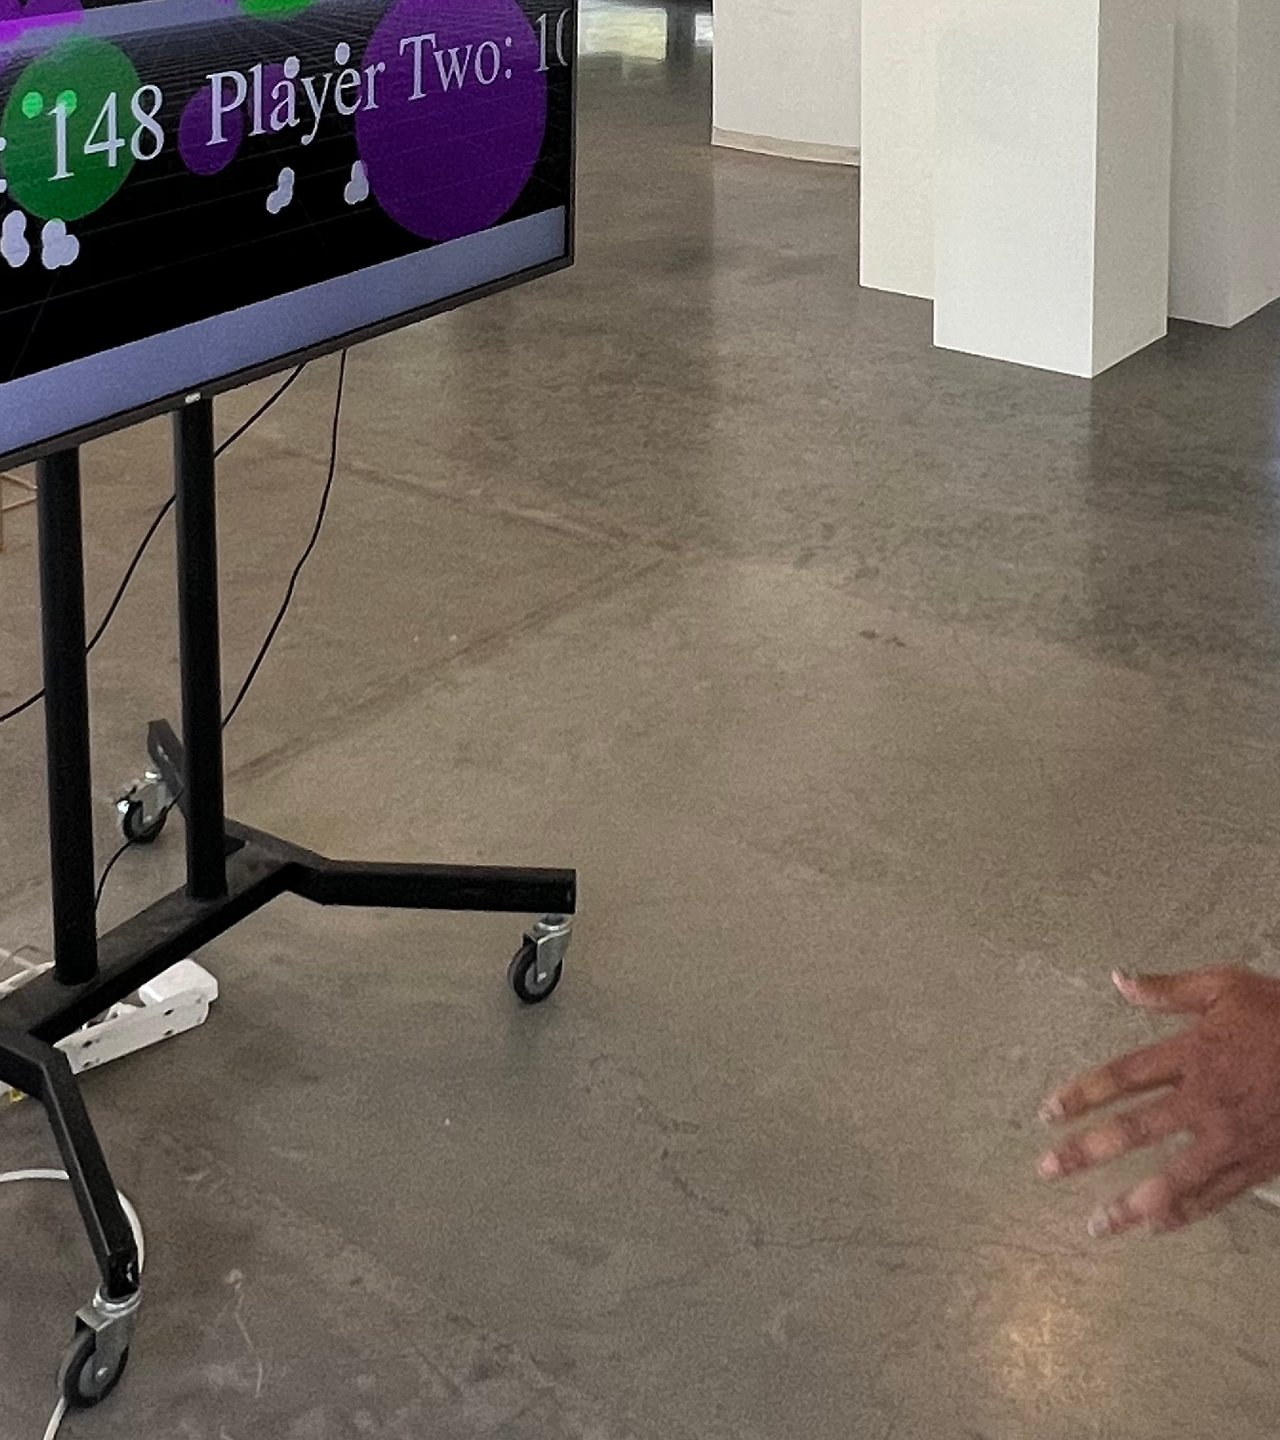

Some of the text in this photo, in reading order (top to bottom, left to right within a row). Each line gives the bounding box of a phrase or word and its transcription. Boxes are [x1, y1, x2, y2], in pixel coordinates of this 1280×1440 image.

[48, 84, 165, 182] 148
[206, 61, 386, 146] Player
[399, 33, 513, 101] Two:
